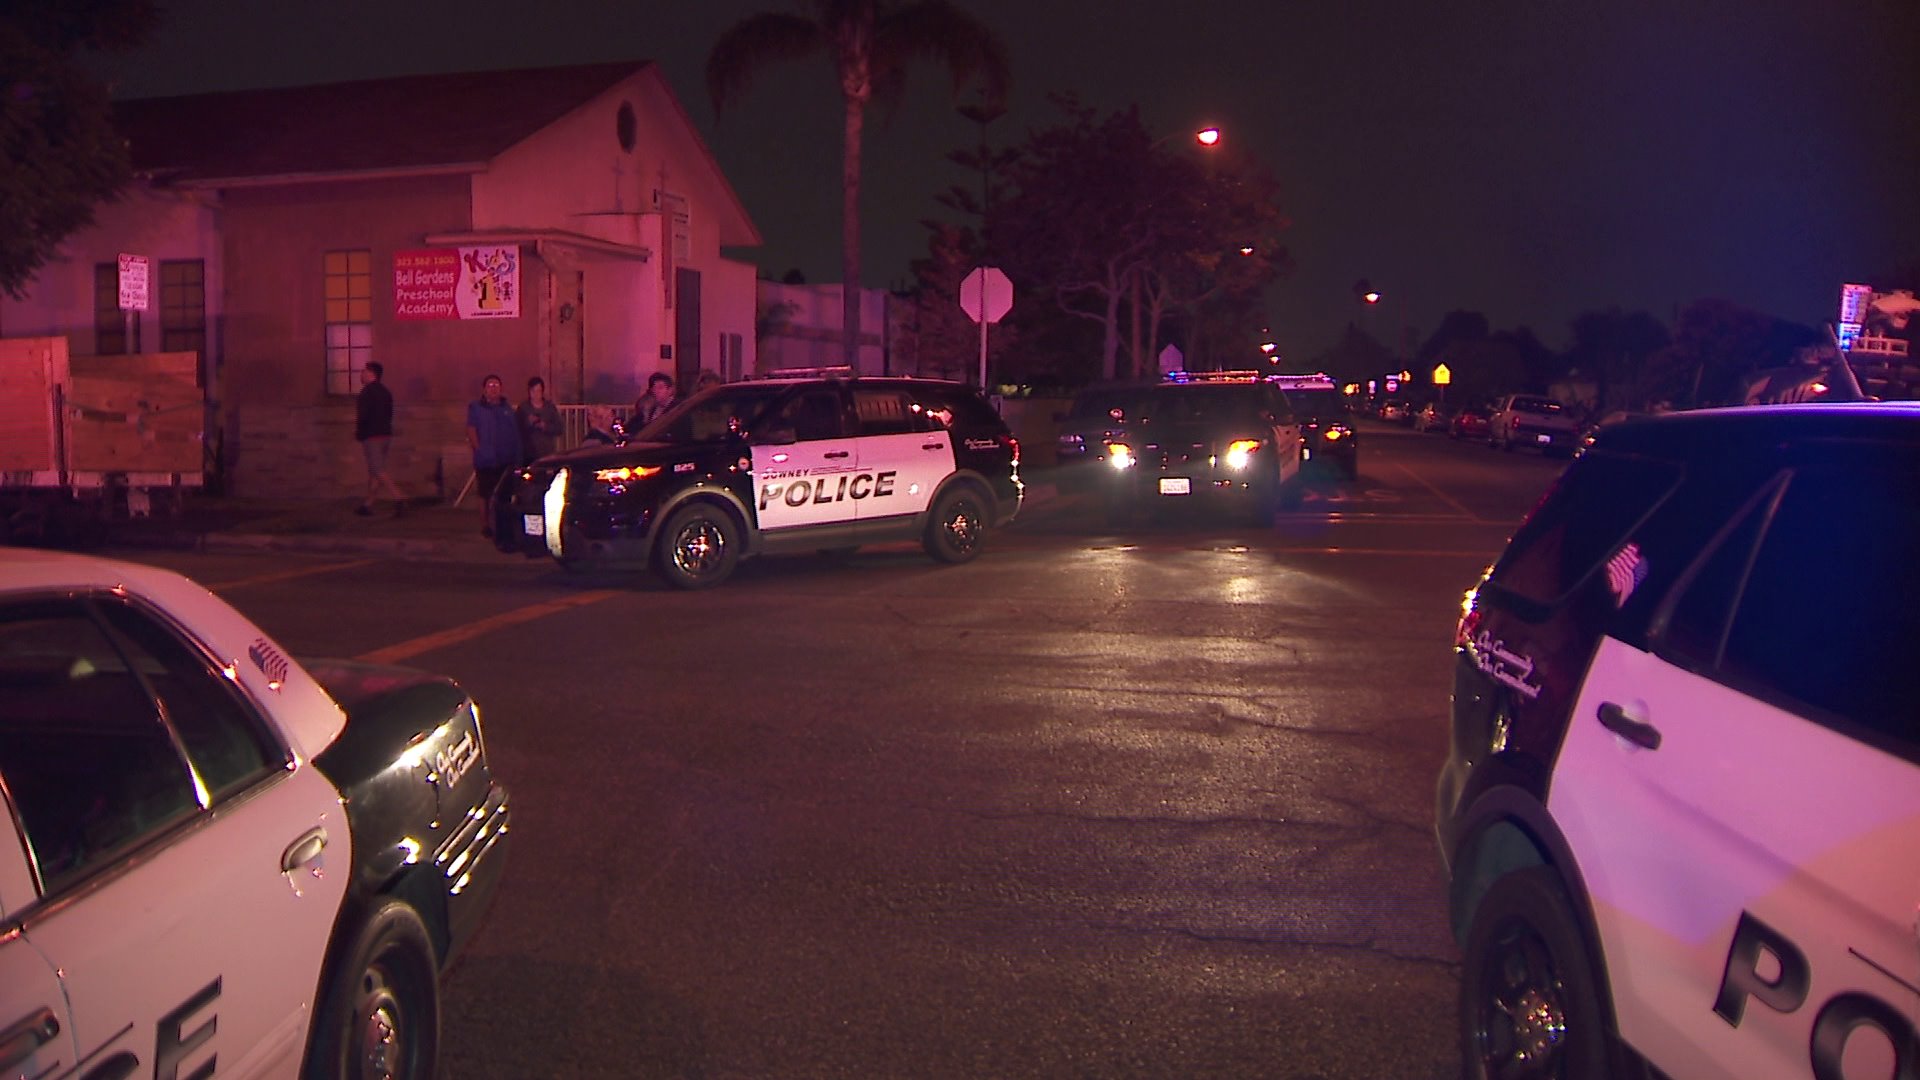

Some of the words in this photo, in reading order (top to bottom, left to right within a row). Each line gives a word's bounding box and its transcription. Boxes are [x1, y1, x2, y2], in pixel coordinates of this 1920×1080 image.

[395, 269, 414, 286] Bell
[415, 268, 454, 286] Gardens
[396, 286, 454, 301] Preschool
[397, 301, 455, 316] Academy
[759, 470, 897, 511] POLICE
[1712, 908, 1920, 1080] PO
